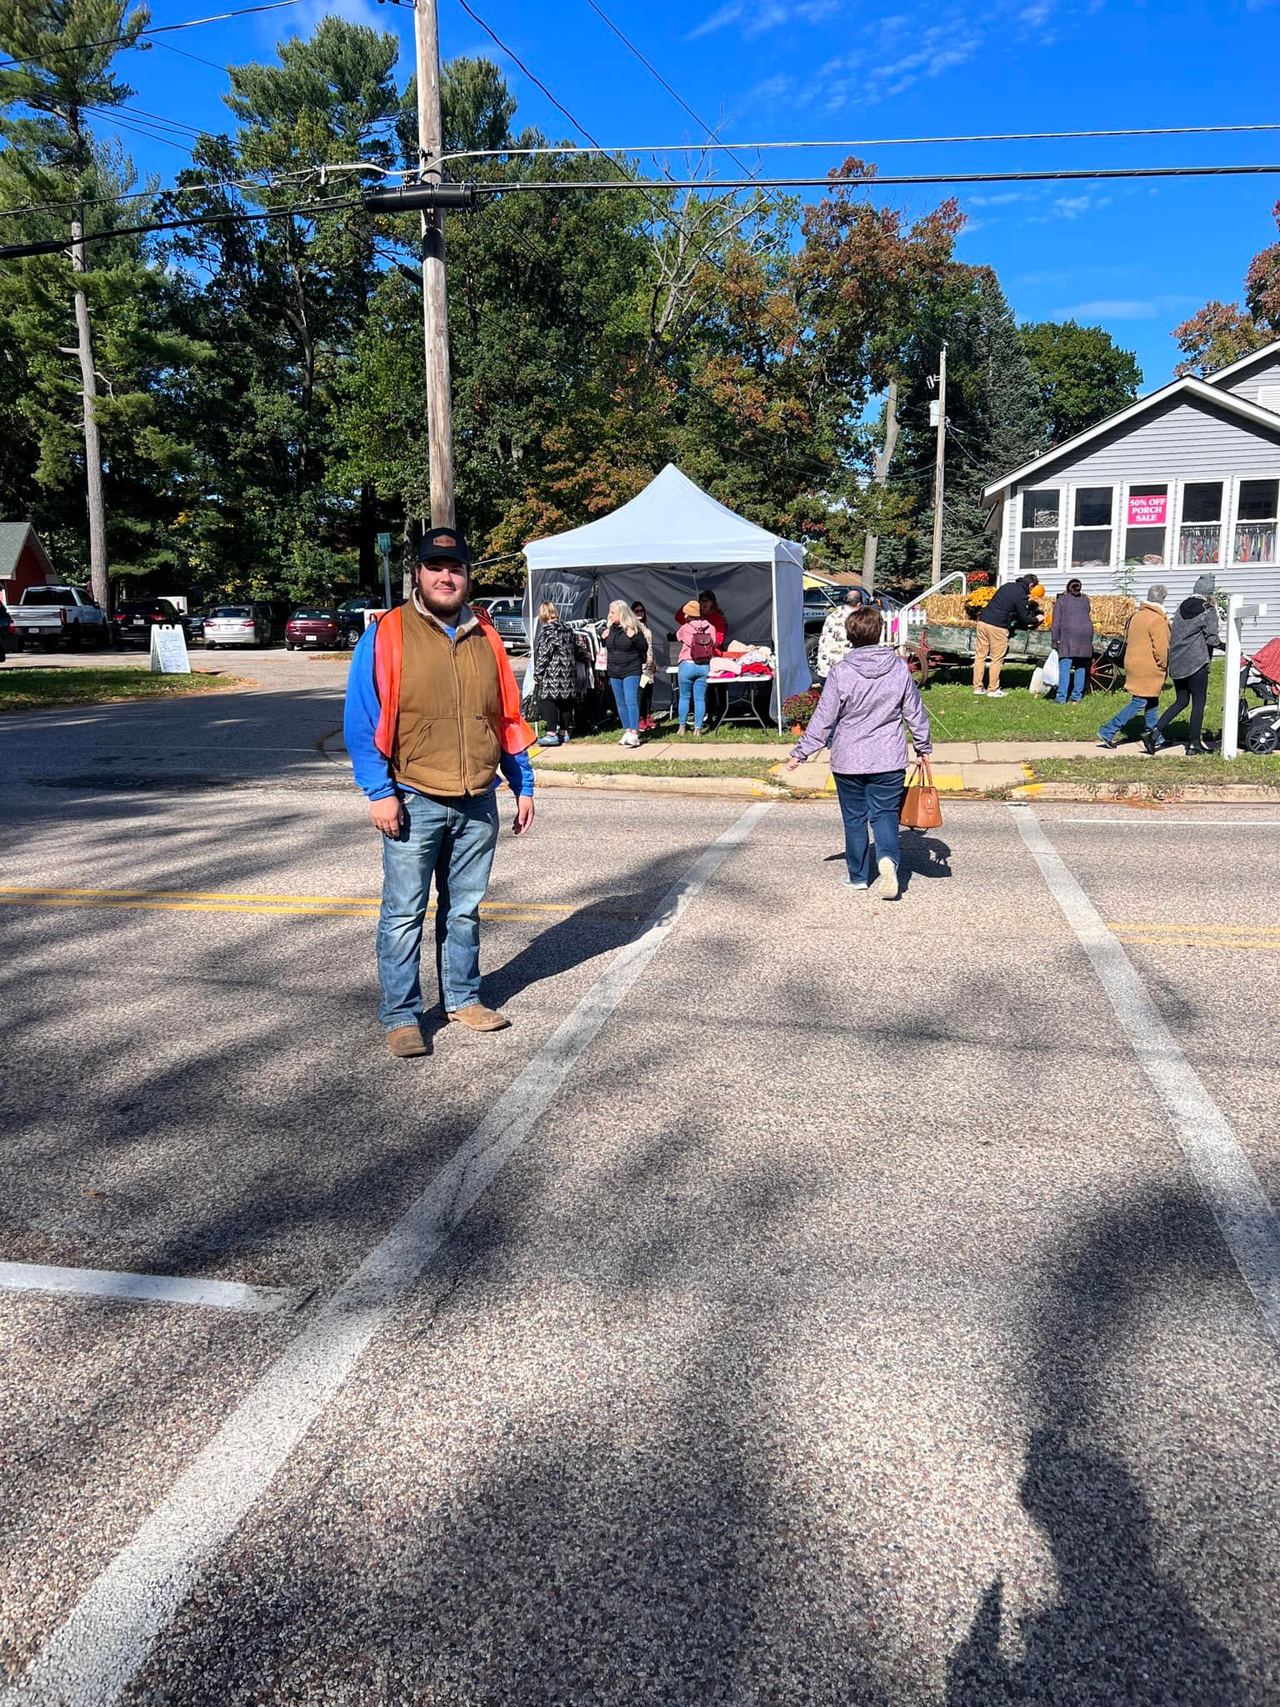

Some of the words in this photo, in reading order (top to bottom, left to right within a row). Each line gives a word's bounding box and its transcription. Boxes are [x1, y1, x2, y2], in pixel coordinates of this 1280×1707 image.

[1149, 498, 1165, 506] OFF
[1132, 506, 1162, 514] PORCH
[1136, 514, 1157, 522] SALE
